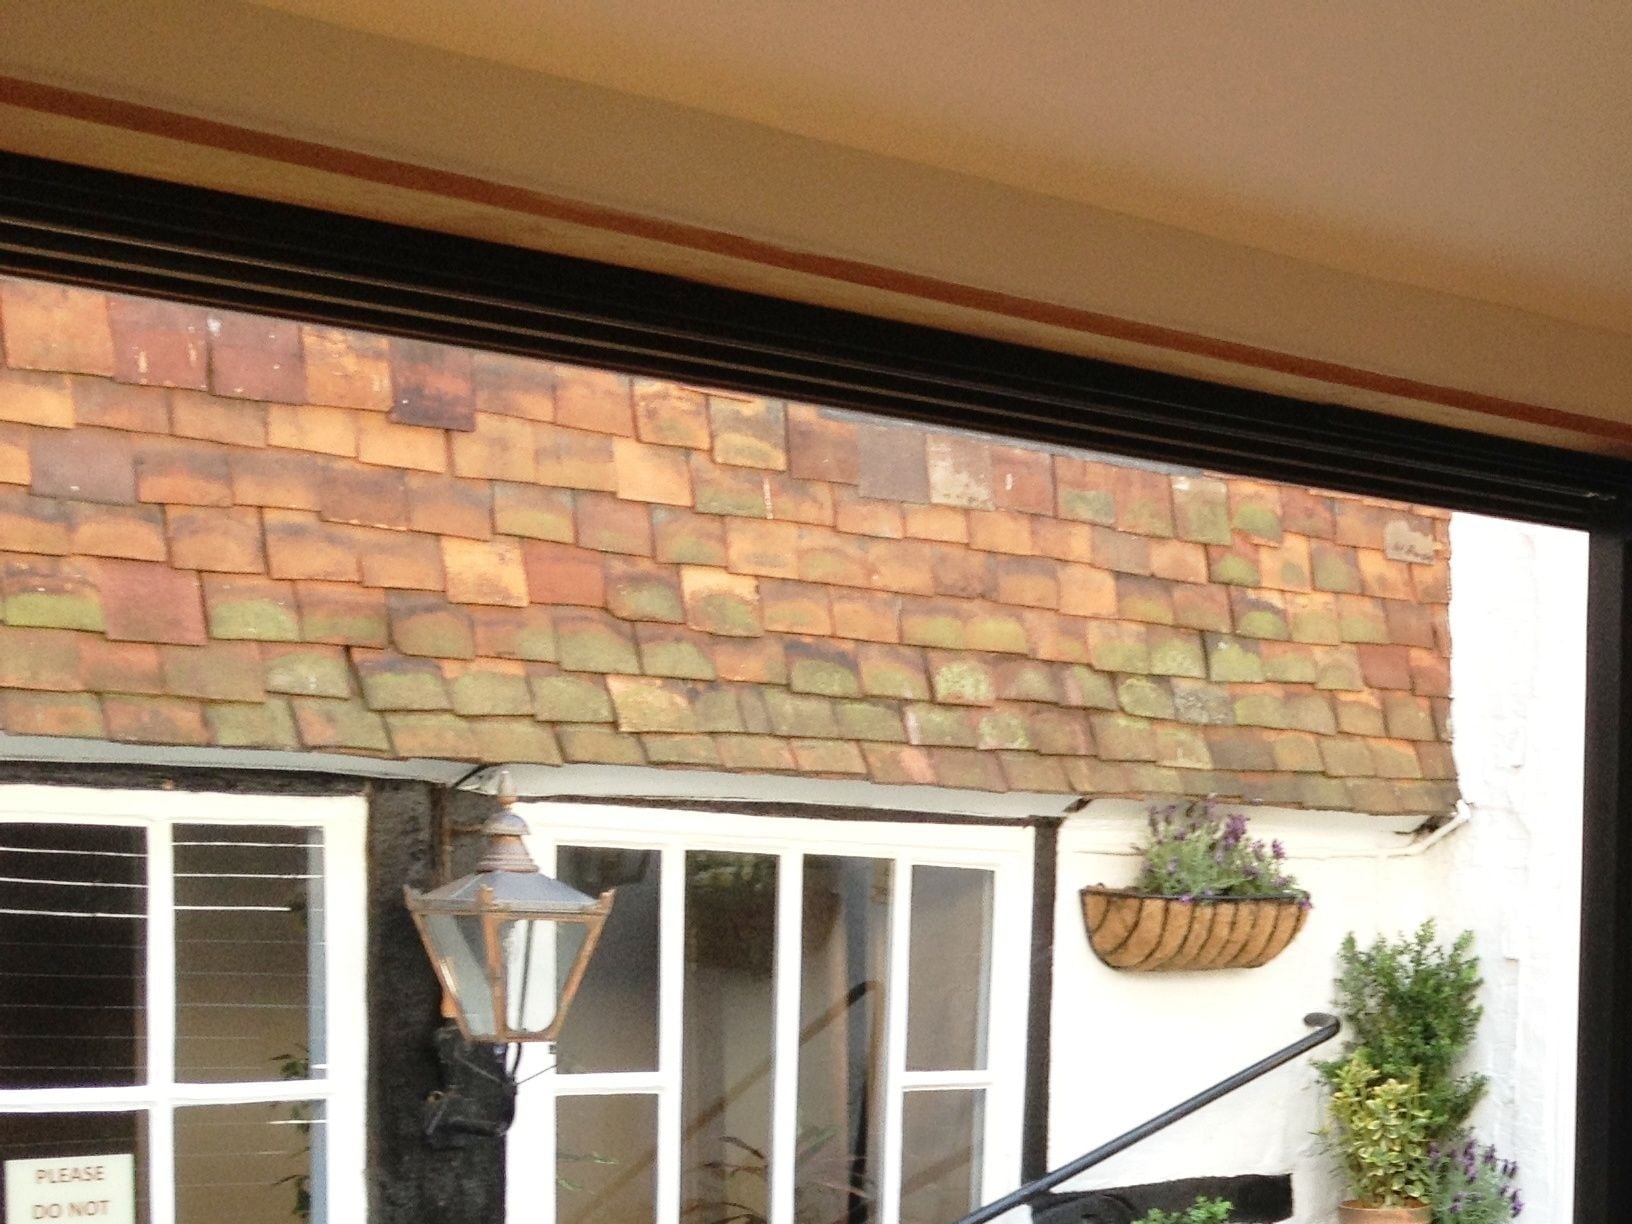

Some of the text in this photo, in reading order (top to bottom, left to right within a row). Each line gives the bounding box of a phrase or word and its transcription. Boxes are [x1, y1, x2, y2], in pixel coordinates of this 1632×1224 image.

[35, 1165, 105, 1184] PLEASE
[32, 1200, 110, 1220] DO NOT
